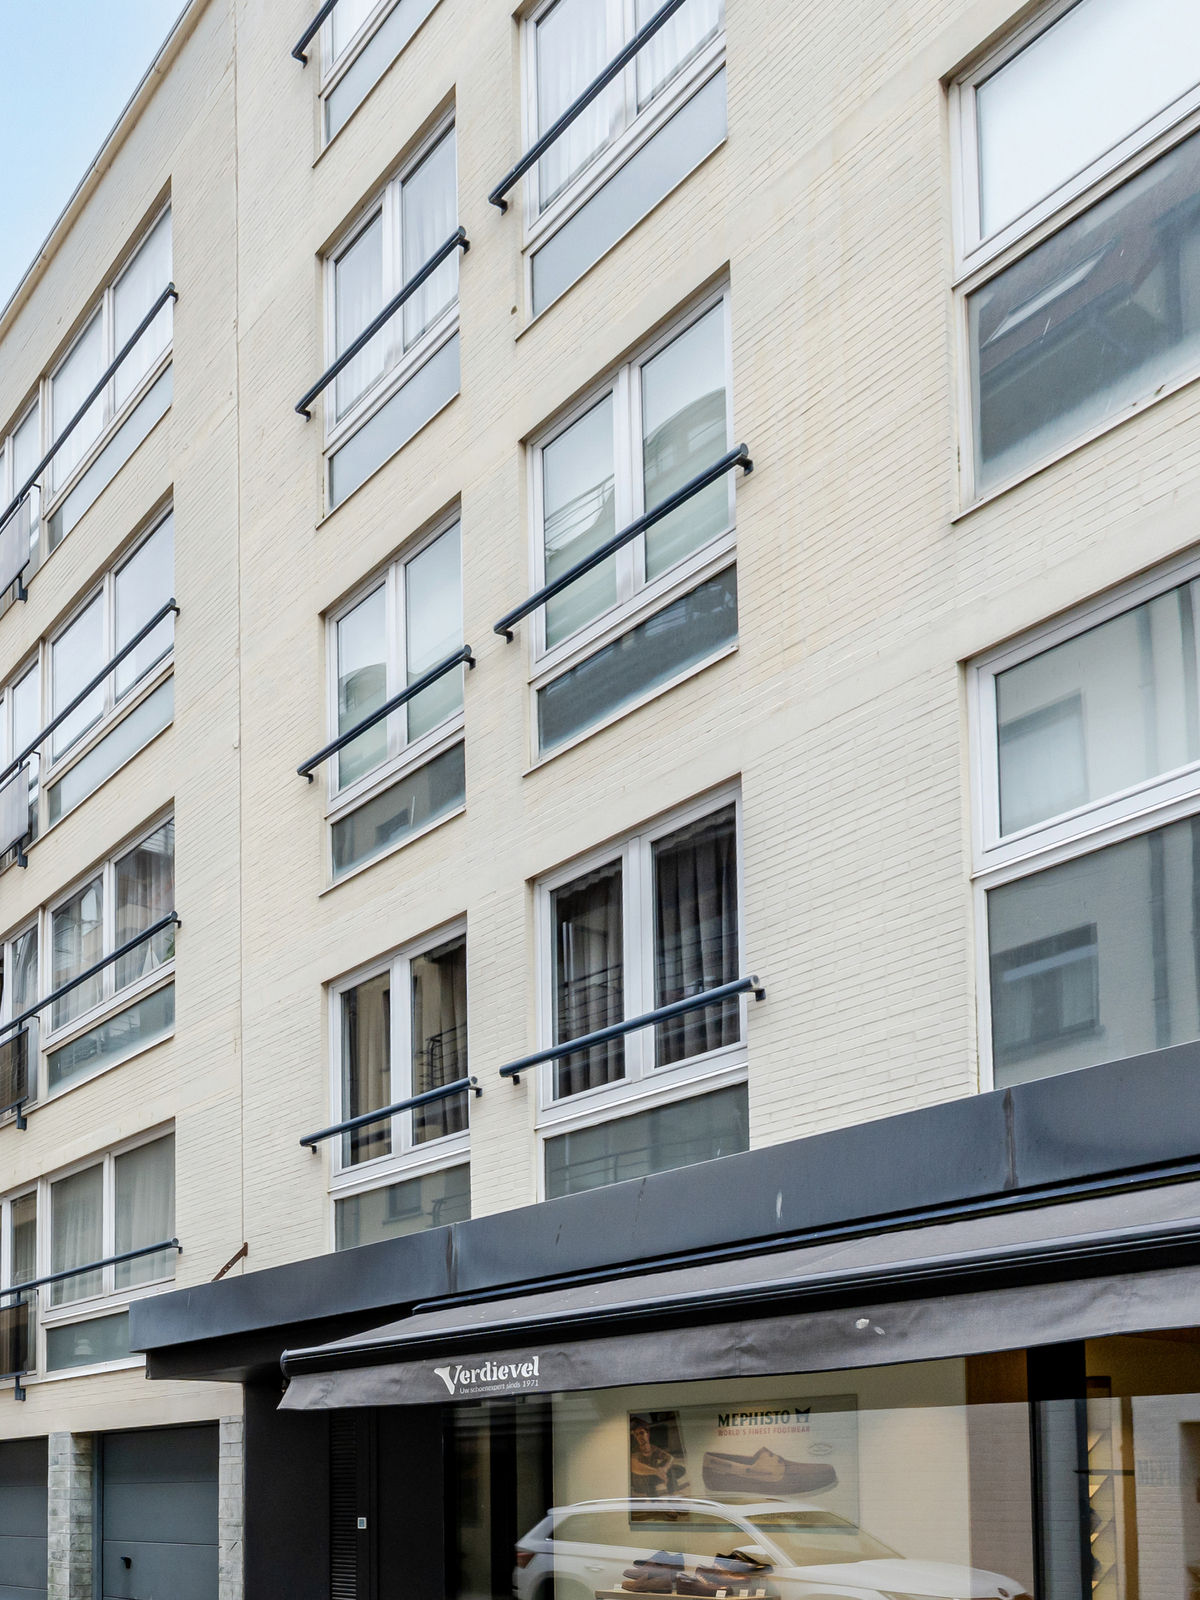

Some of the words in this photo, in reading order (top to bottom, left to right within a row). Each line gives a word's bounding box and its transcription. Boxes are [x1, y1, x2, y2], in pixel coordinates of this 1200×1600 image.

[434, 1356, 539, 1395] Verdievel
[470, 1384, 505, 1393] schoenexpert
[506, 1381, 521, 1389] sinds
[522, 1379, 539, 1388] 1971
[718, 1410, 790, 1427] MEPHISTO
[748, 1427, 771, 1435] FINEST
[773, 1426, 810, 1434] FOOTWEAR
